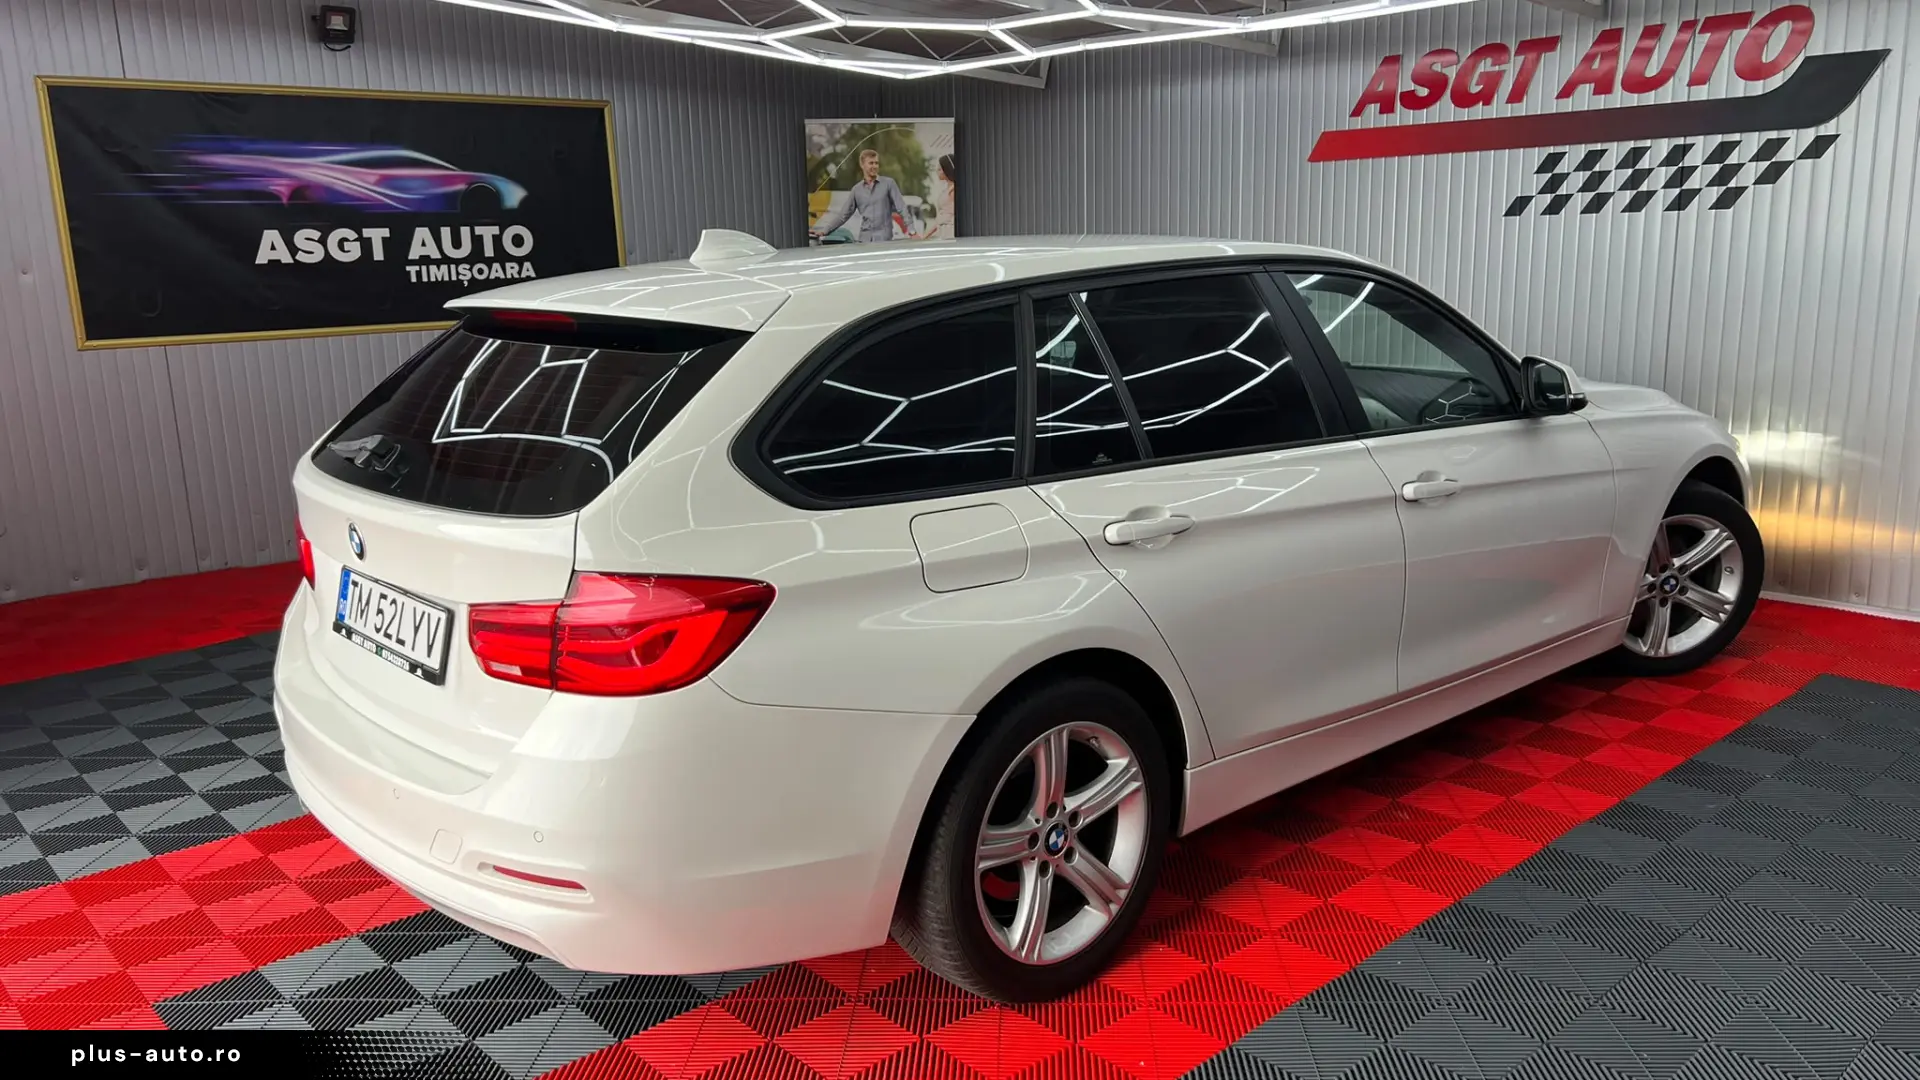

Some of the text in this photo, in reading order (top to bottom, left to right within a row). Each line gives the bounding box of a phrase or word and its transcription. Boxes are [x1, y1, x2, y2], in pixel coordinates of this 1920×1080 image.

[1350, 4, 1815, 118] ASGT AUTO
[255, 225, 534, 265] ASGT AUTO
[406, 262, 536, 286] TIMIȘOARA
[349, 579, 372, 628] TM
